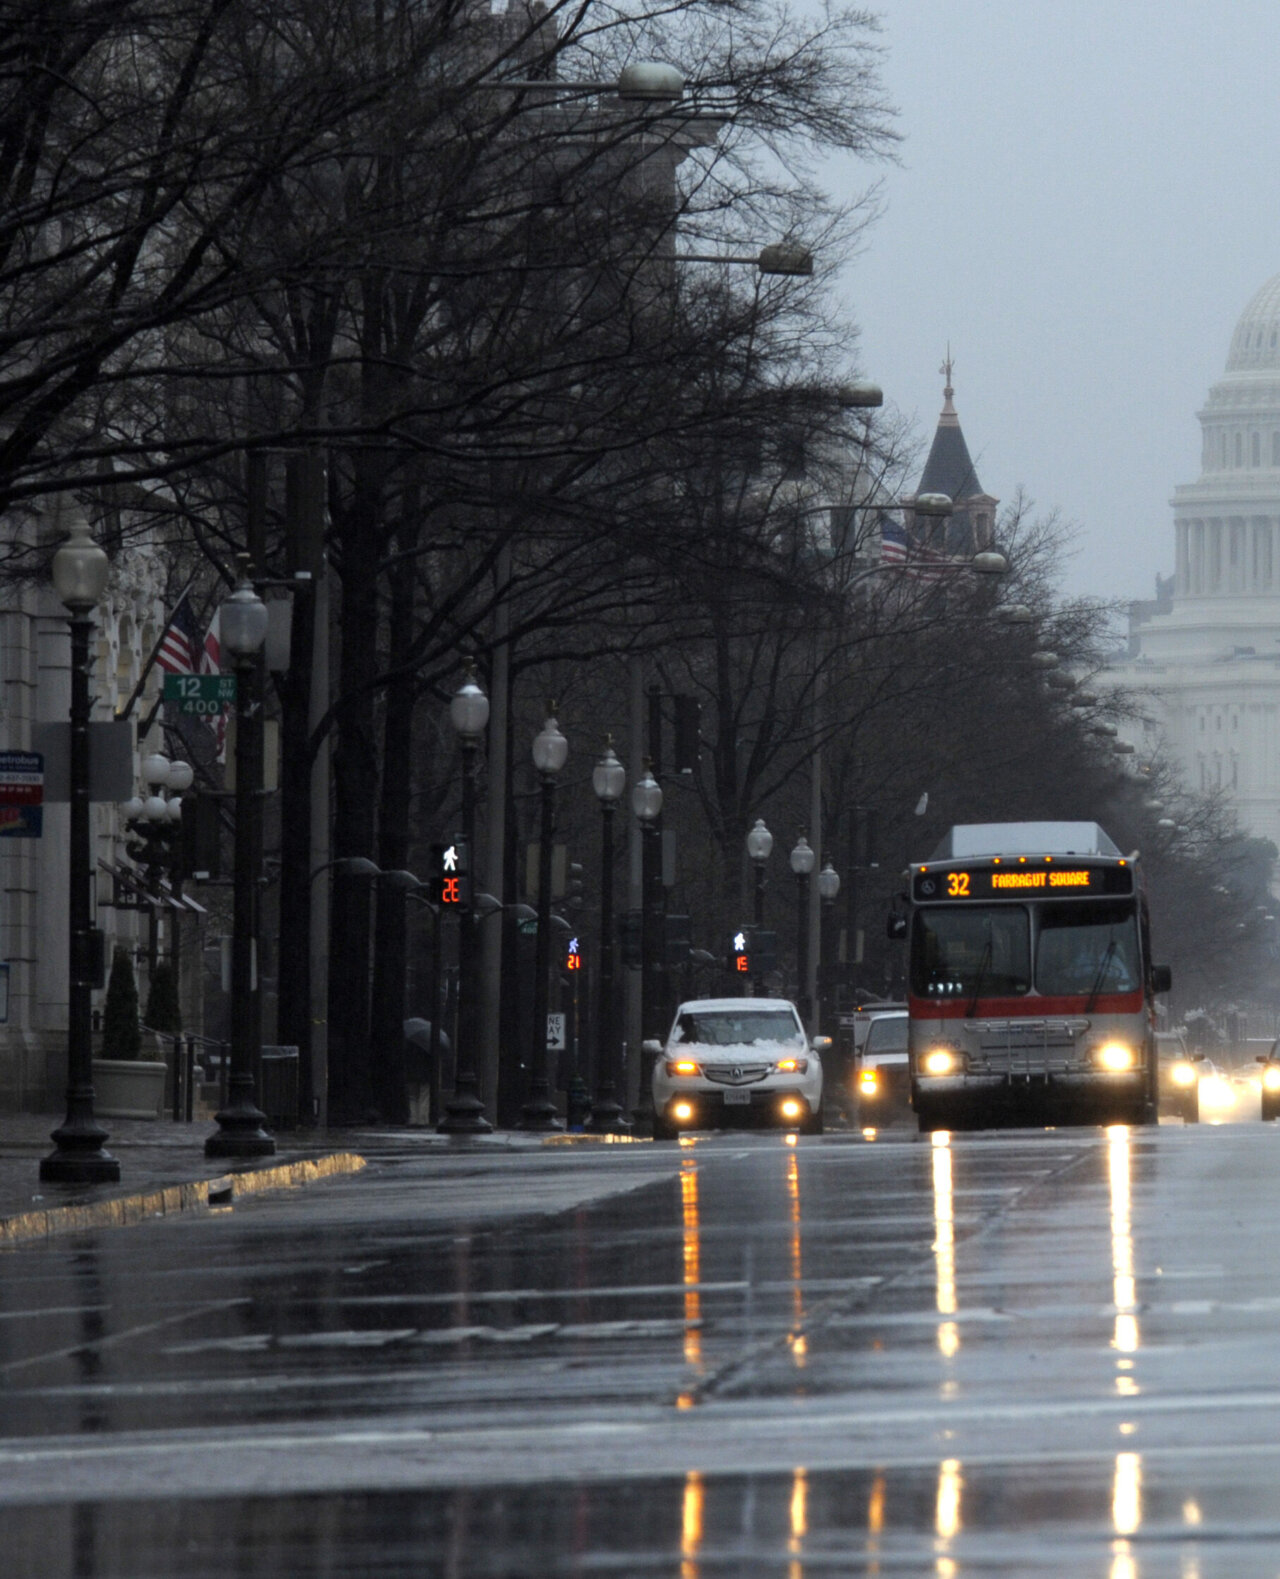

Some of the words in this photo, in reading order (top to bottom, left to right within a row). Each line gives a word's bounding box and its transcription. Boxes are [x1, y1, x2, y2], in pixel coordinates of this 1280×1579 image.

[176, 677, 201, 697] 12
[219, 679, 233, 688] ST
[217, 688, 235, 697] NW
[183, 699, 219, 714] 400
[0, 755, 39, 765] etrobus
[947, 872, 970, 896] 32
[991, 873, 1047, 888] FARRAGUT
[1049, 871, 1090, 886] SQUARE
